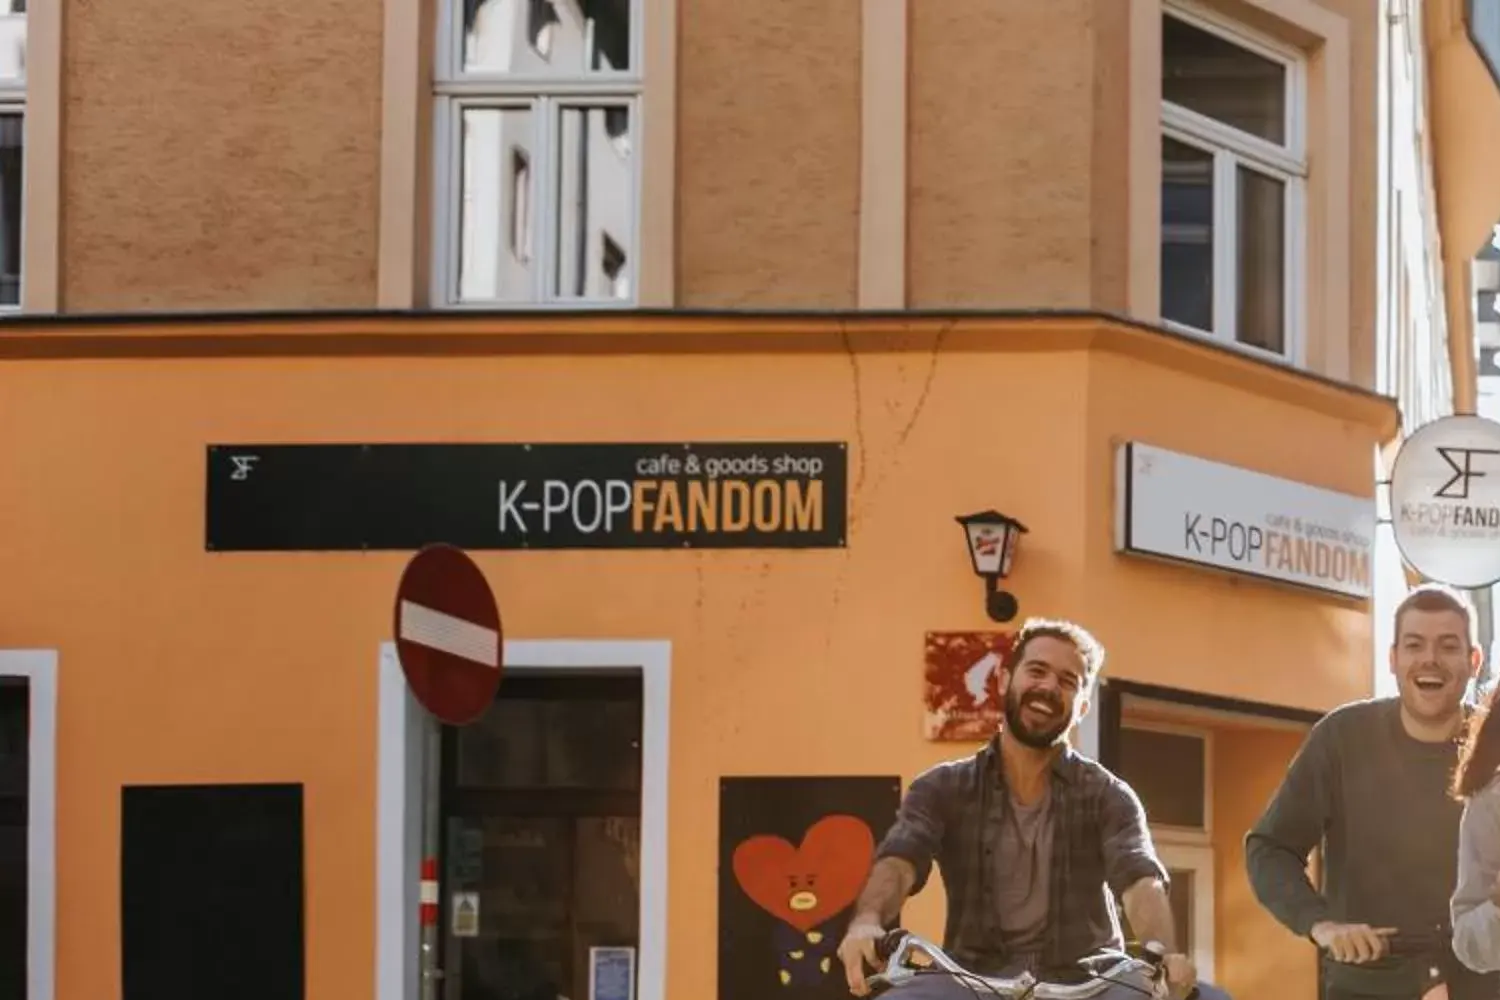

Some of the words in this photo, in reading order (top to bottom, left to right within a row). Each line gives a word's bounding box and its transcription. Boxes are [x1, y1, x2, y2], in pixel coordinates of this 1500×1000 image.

[635, 453, 681, 474] cafe
[684, 454, 700, 474] &
[705, 454, 769, 478] goods
[772, 453, 823, 477] shop
